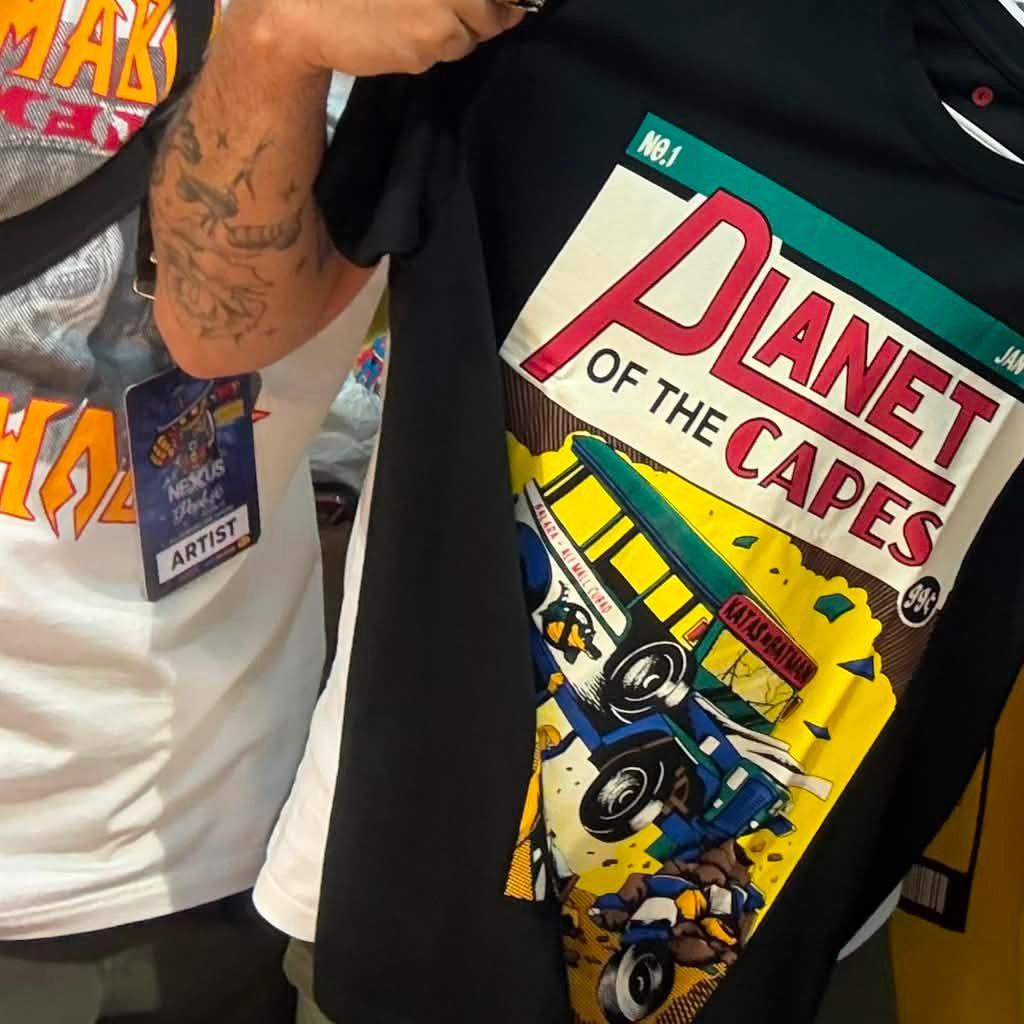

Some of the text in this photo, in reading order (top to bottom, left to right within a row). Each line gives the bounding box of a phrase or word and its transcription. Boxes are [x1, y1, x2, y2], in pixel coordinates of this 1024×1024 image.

[519, 186, 1000, 506] PLANET
[586, 347, 944, 568] OF THE CAPES
[171, 517, 237, 571] ARTIST
[723, 597, 768, 643] KATAS
